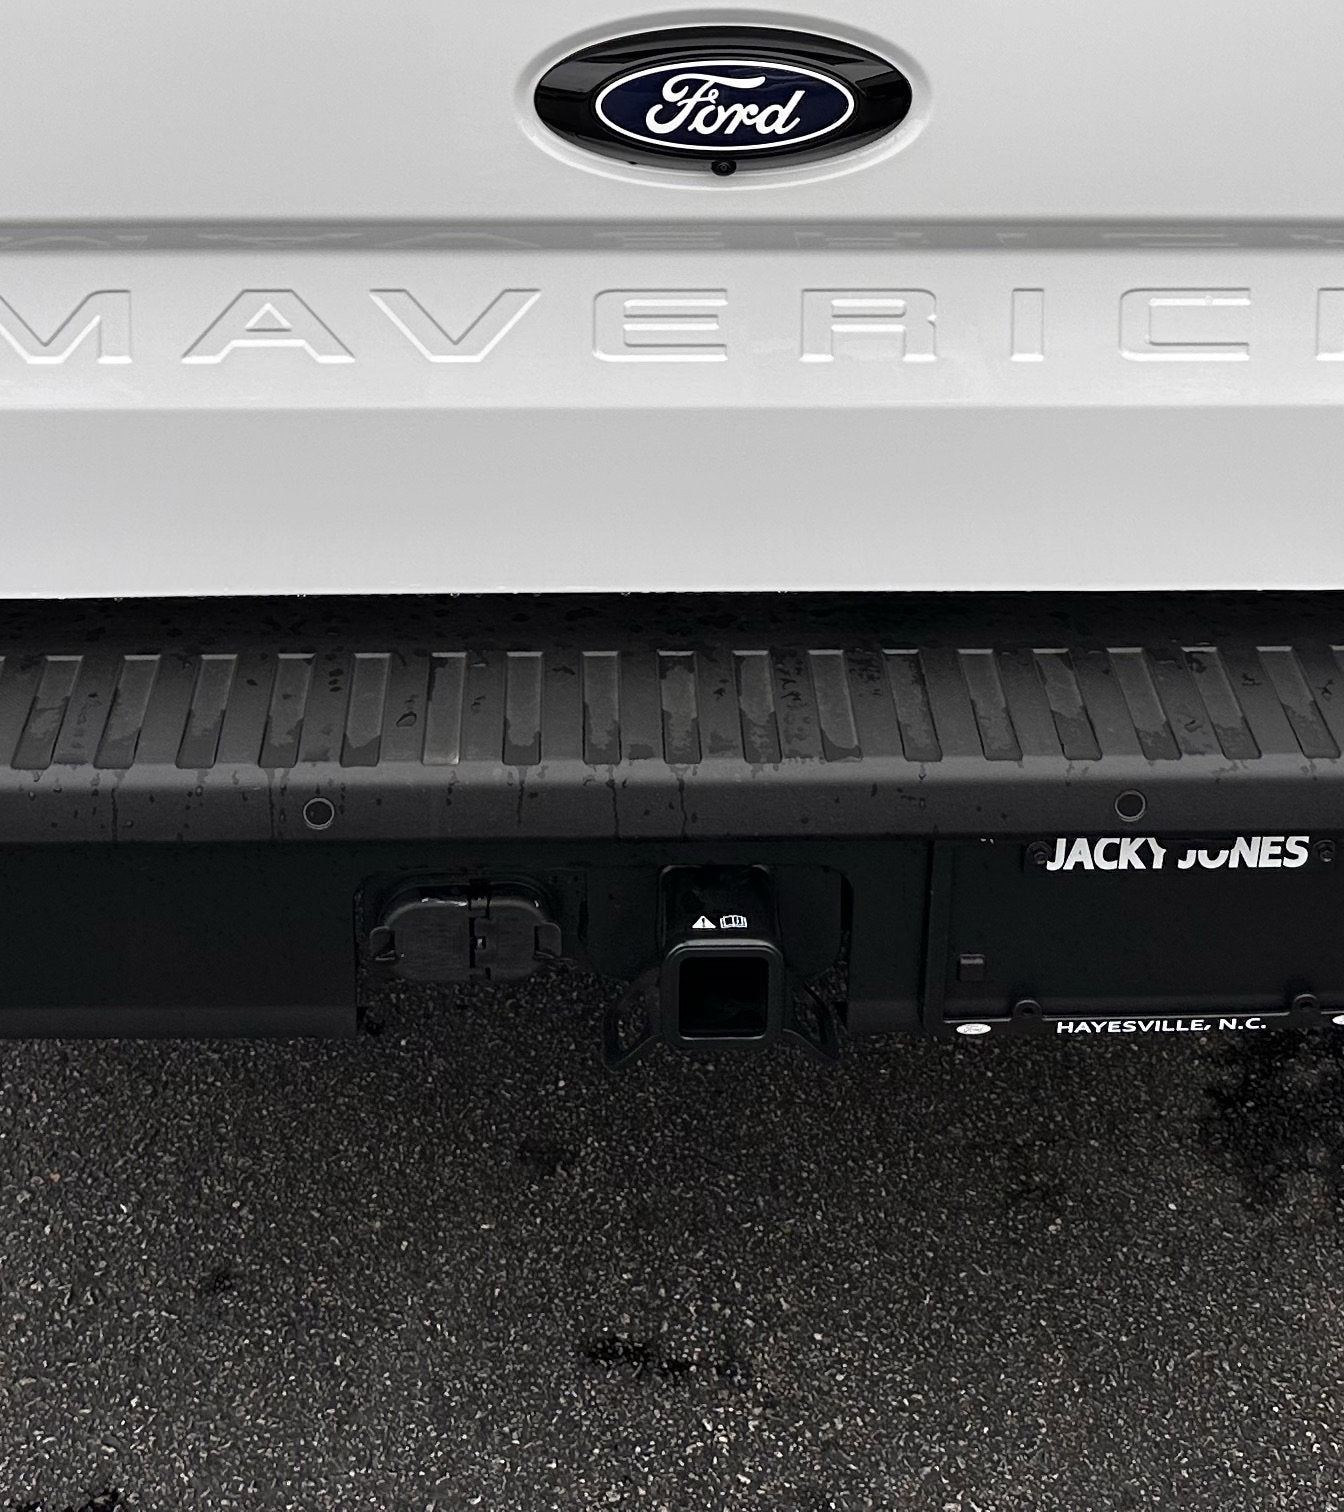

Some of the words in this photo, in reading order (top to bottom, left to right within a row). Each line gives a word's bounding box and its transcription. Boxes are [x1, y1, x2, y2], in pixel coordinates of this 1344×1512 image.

[645, 72, 805, 135] Ford
[1046, 836, 1167, 871] JACKY
[1056, 1020, 1212, 1035] HAYESVILLE,
[1218, 1017, 1267, 1031] N.C.
